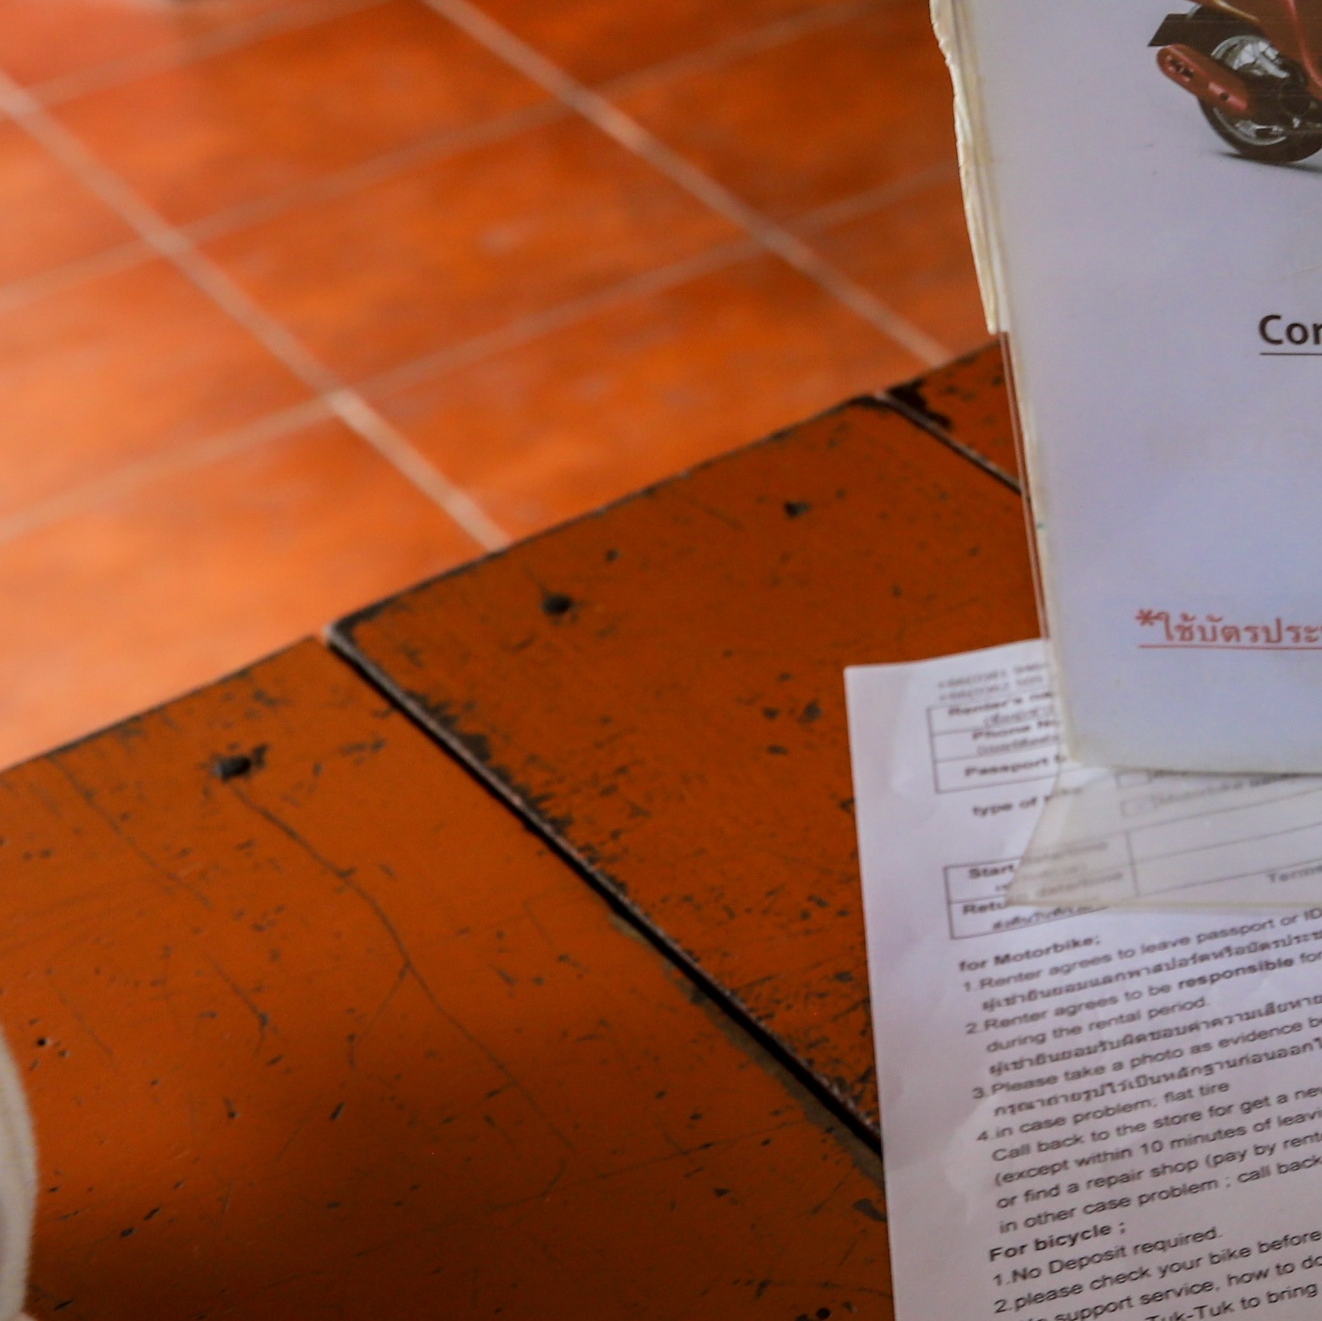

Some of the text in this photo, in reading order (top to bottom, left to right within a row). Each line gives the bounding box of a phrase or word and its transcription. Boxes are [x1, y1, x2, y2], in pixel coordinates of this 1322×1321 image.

[964, 756, 1049, 777] Passport
[972, 796, 1038, 817] type of
[968, 862, 1015, 879] Start
[958, 960, 987, 972] for
[1049, 954, 1112, 975] agrees
[1140, 937, 1191, 954] leave
[1196, 919, 1274, 945] passport
[1055, 996, 1118, 1017] agrees
[1148, 984, 1171, 996] be
[1178, 958, 1294, 989] responsible
[1299, 951, 1322, 963] for
[986, 1033, 1046, 1052] during
[1052, 1026, 1082, 1038] the
[1088, 1010, 1141, 1031] rental
[1064, 1066, 1106, 1081] take
[1130, 1048, 1184, 1070] photo
[1190, 1043, 1212, 1054] as
[1218, 1022, 1303, 1048] evidence
[992, 1144, 1031, 1161] Call
[1037, 1134, 1084, 1152] back
[1090, 1131, 1110, 1142] to
[1116, 1123, 1146, 1136] the
[1153, 1111, 1202, 1128] store
[1208, 1104, 1234, 1117] for
[1240, 1096, 1271, 1114] get
[1019, 1117, 1066, 1133] case
[1164, 1089, 1194, 1102] flat
[1199, 1082, 1230, 1096] tire
[994, 1160, 1069, 1187] (except
[1074, 1148, 1133, 1167] within
[1140, 1140, 1164, 1154] 10
[1170, 1126, 1247, 1149] minutes
[1253, 1118, 1271, 1132] of
[1023, 1184, 1061, 1202] find
[1086, 1170, 1143, 1189] repair
[1150, 1160, 1199, 1178] shop
[1205, 1149, 1247, 1168] (pay
[1024, 1208, 1076, 1228] other
[1082, 1197, 1131, 1215] case
[1138, 1179, 1218, 1207] problem
[1237, 1166, 1271, 1183] call
[989, 1225, 1111, 1262] For bicycle
[1048, 1246, 1127, 1274] Deposit
[1090, 1267, 1151, 1290] check
[1158, 1257, 1203, 1279] your
[1209, 1247, 1251, 1265] bike
[1257, 1231, 1322, 1253] before
[1227, 1268, 1269, 1286] how
[1275, 1263, 1295, 1276] to
[1240, 1297, 1261, 1310] to
[1266, 1284, 1318, 1304] bring
